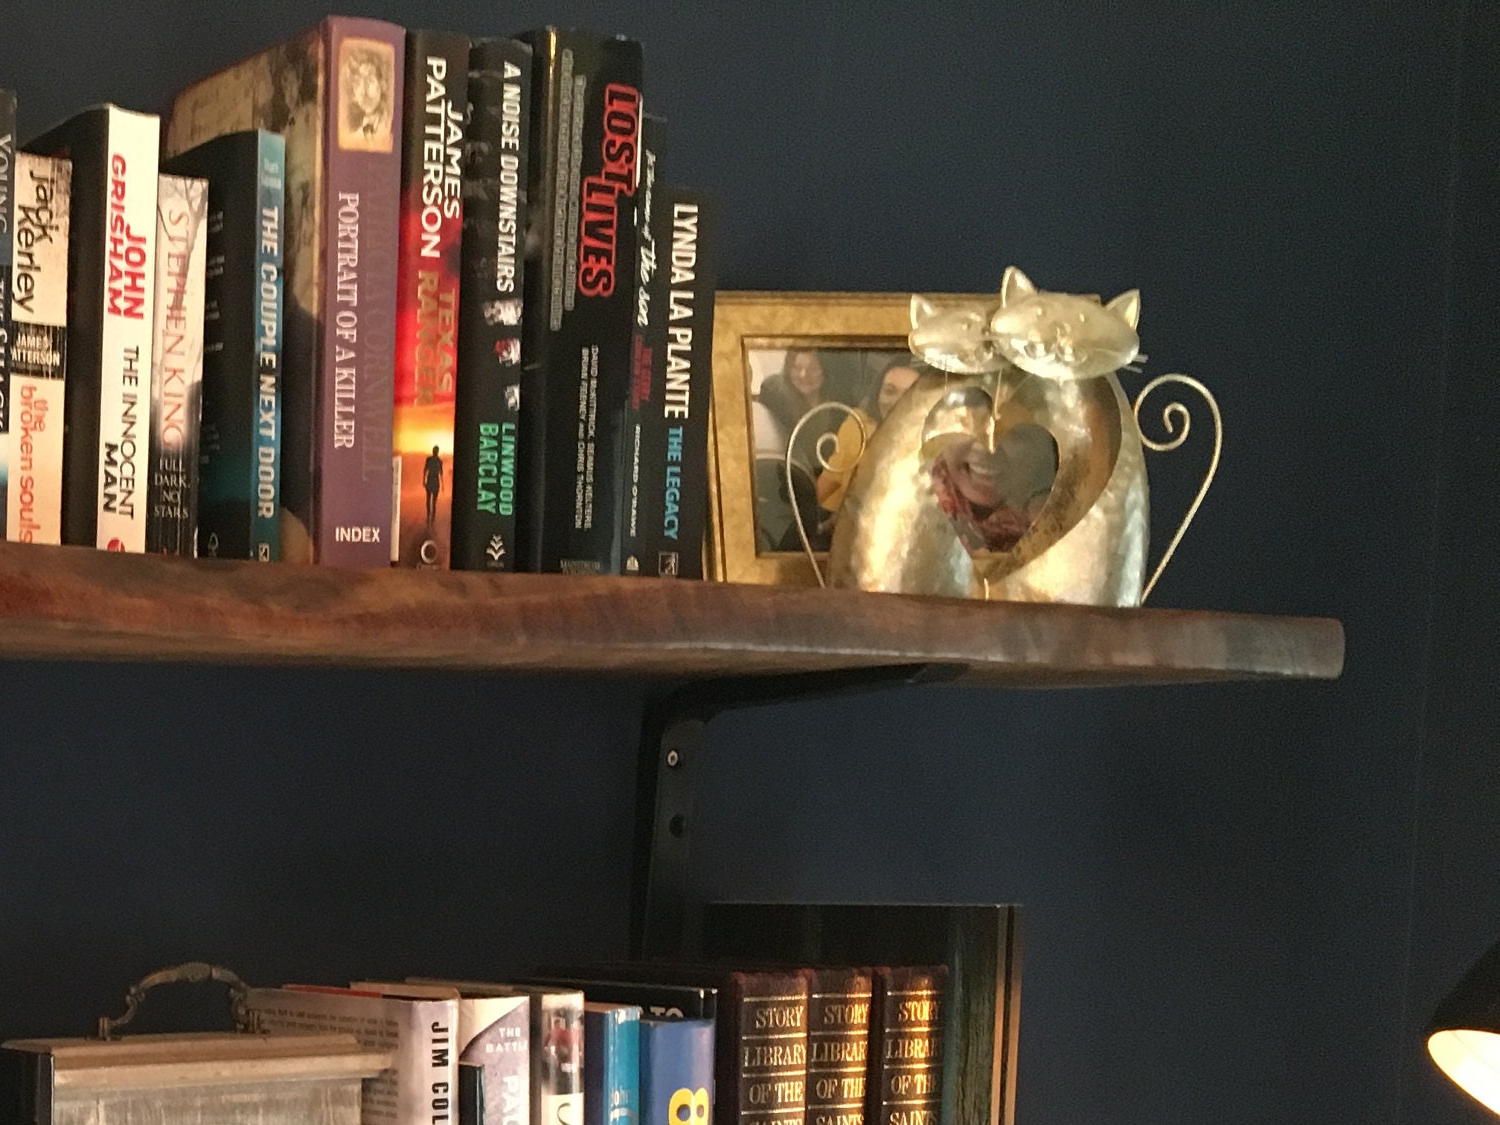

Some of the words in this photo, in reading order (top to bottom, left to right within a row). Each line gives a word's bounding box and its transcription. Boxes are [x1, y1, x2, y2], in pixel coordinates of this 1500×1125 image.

[502, 61, 522, 79] A
[500, 83, 521, 152] NOISE
[603, 84, 638, 196] LOST
[420, 56, 447, 259] PATTERSON
[443, 100, 464, 220] JAMES
[29, 170, 61, 244] Jack
[107, 152, 127, 317] GRISHAM
[261, 206, 279, 256] THE
[495, 154, 519, 292] DOWNSTAIRS
[578, 178, 618, 297] LIVES
[669, 202, 698, 284] LYNDA
[11, 203, 41, 315] Kerley
[123, 225, 147, 320] JOHN
[162, 208, 190, 357] STEPHEN
[336, 191, 360, 306] PORTRAIT
[259, 261, 279, 369] COUPLE
[335, 312, 358, 344] OF
[413, 269, 439, 407] RANGER
[436, 287, 457, 393] TEXAS
[637, 286, 651, 327] son
[669, 291, 695, 321] LA
[122, 345, 140, 387] THE
[334, 345, 357, 363] A
[664, 326, 693, 420] PLANTE
[19, 384, 38, 471] broken
[33, 399, 49, 433] the
[161, 366, 186, 448] KING
[258, 374, 277, 441] NEXT
[333, 366, 357, 449] KILLER
[668, 426, 684, 461] THE
[102, 442, 120, 513] MAN
[117, 391, 138, 520] INNOCENT
[159, 458, 186, 472] FULL
[257, 446, 275, 519] DOOR
[476, 422, 499, 515] BARCLAY
[499, 422, 516, 517] LINWOOD
[19, 476, 41, 544] souls
[335, 526, 381, 543] INDEX
[663, 466, 682, 540] LEGACY
[431, 1021, 449, 1068] JIM
[498, 1027, 521, 1038] THE
[755, 1005, 805, 1030] STORY
[823, 1003, 869, 1026] STORY
[743, 1043, 807, 1067] LIBRARY
[749, 1083, 772, 1104] OF
[774, 1079, 804, 1103] THE
[815, 1078, 839, 1100] OF
[840, 1076, 866, 1099] THE
[890, 1074, 912, 1095] OF
